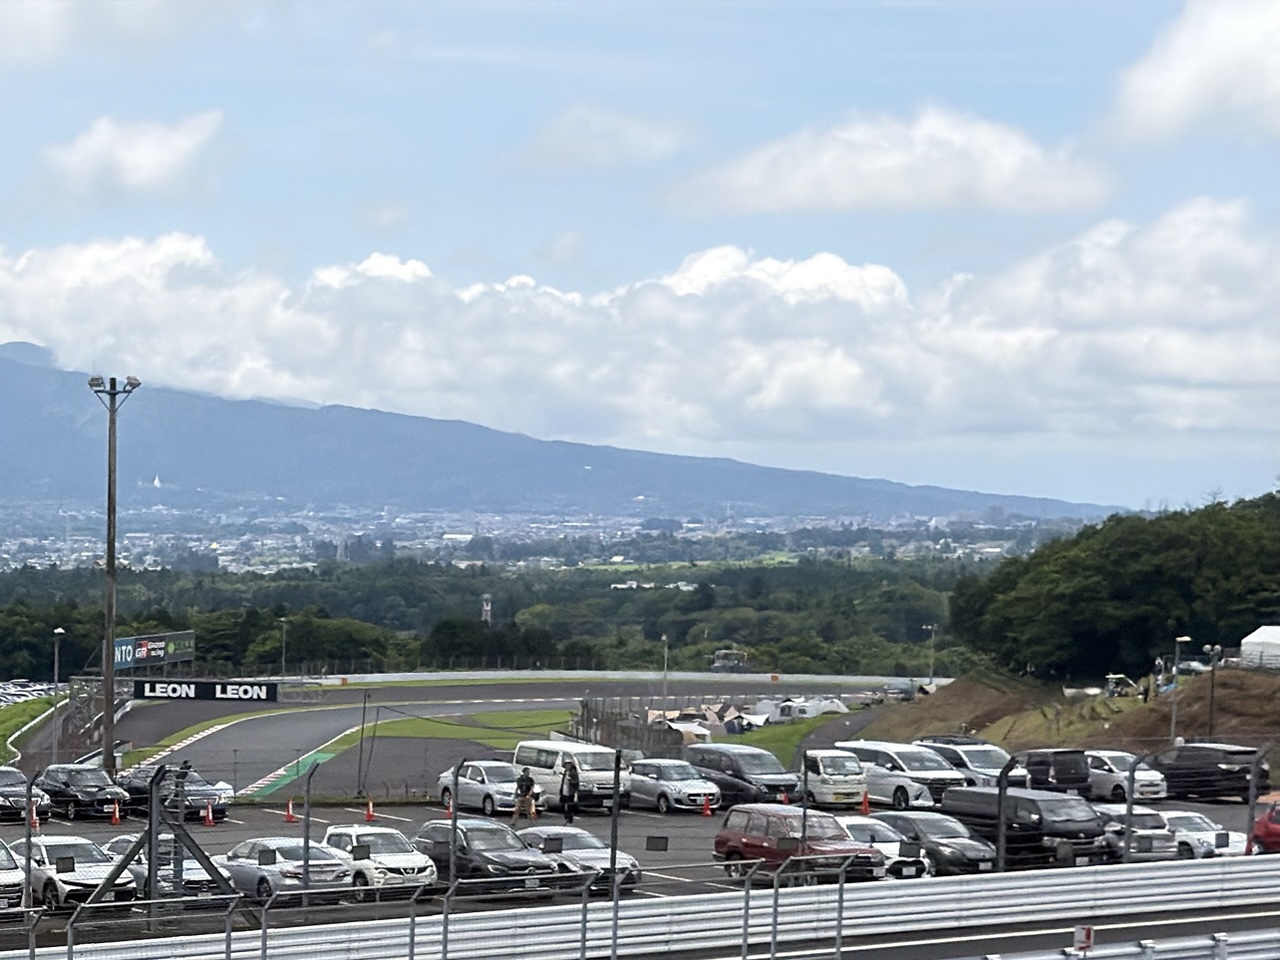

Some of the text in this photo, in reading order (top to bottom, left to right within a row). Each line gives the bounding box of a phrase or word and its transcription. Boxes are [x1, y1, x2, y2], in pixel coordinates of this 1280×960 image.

[115, 645, 133, 662] NTO
[144, 683, 267, 699] LEON LEON
